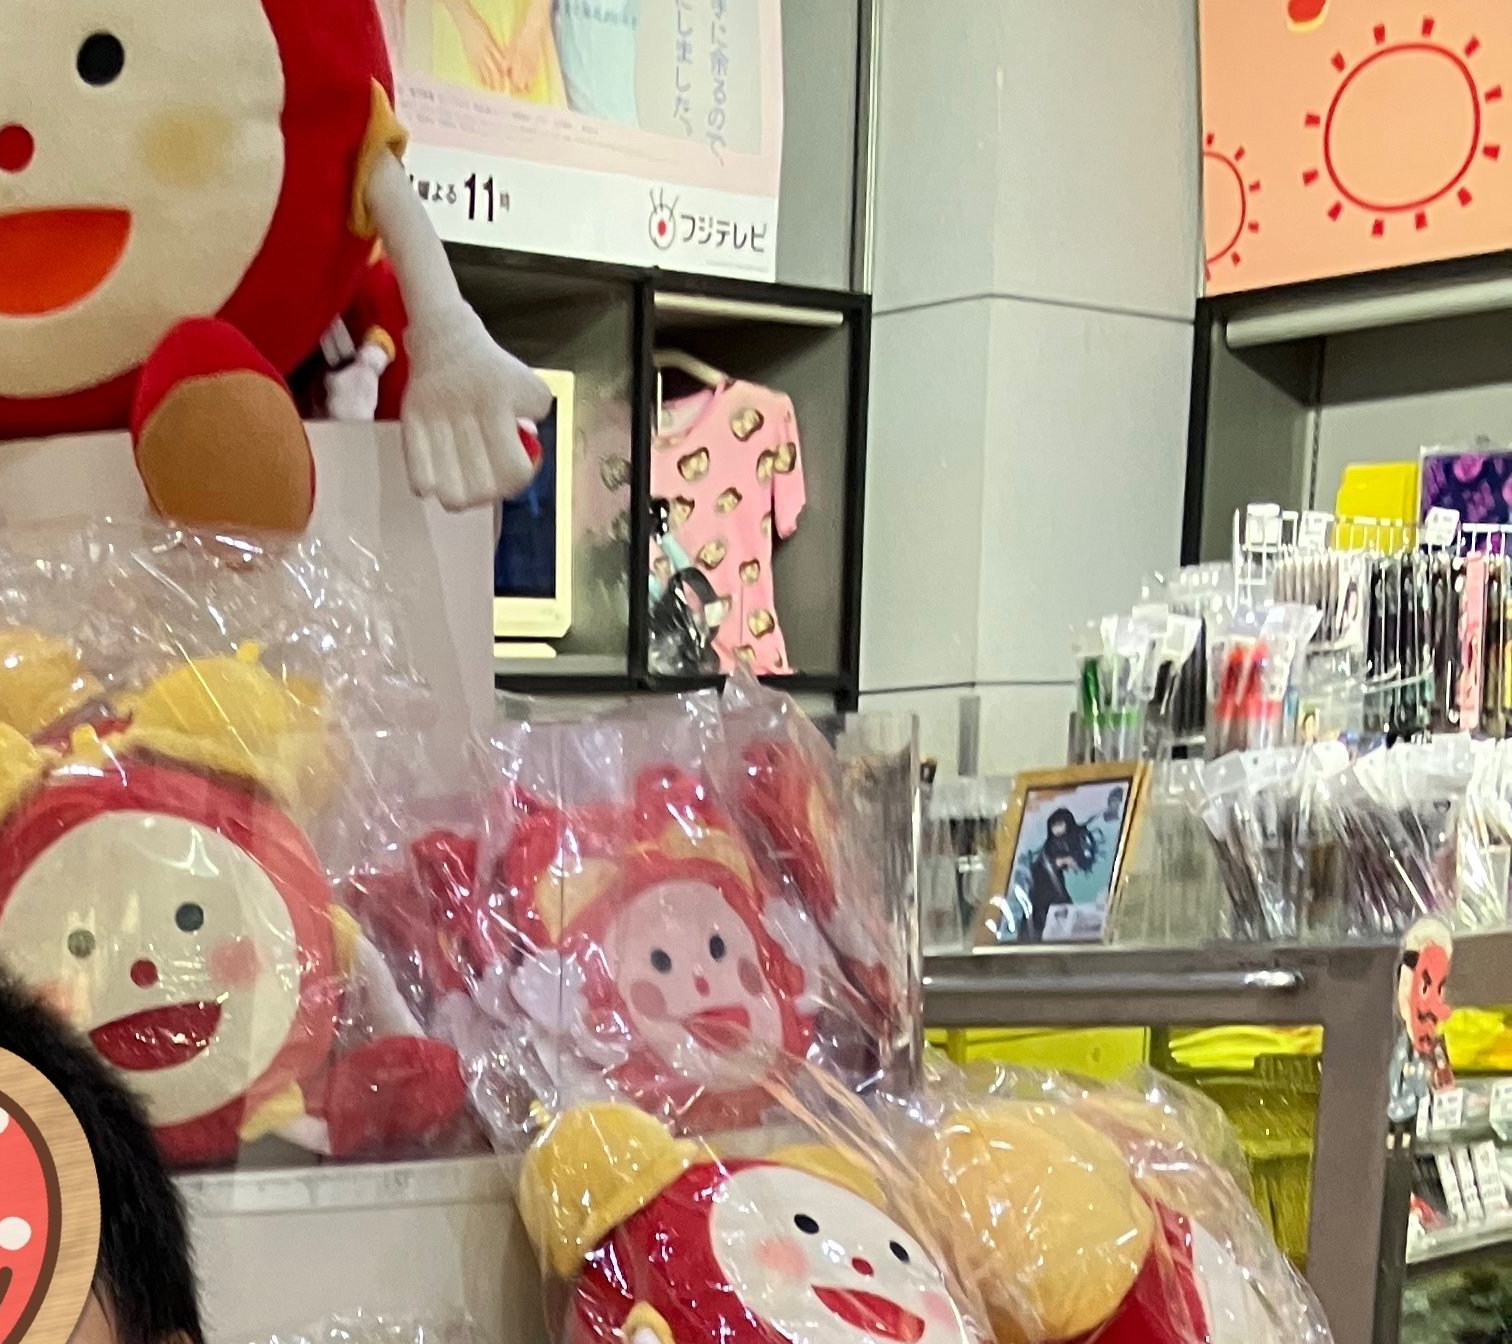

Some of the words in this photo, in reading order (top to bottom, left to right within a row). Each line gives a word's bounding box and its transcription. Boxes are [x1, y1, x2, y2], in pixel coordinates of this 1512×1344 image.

[680, 213, 768, 253] フジテレビ
